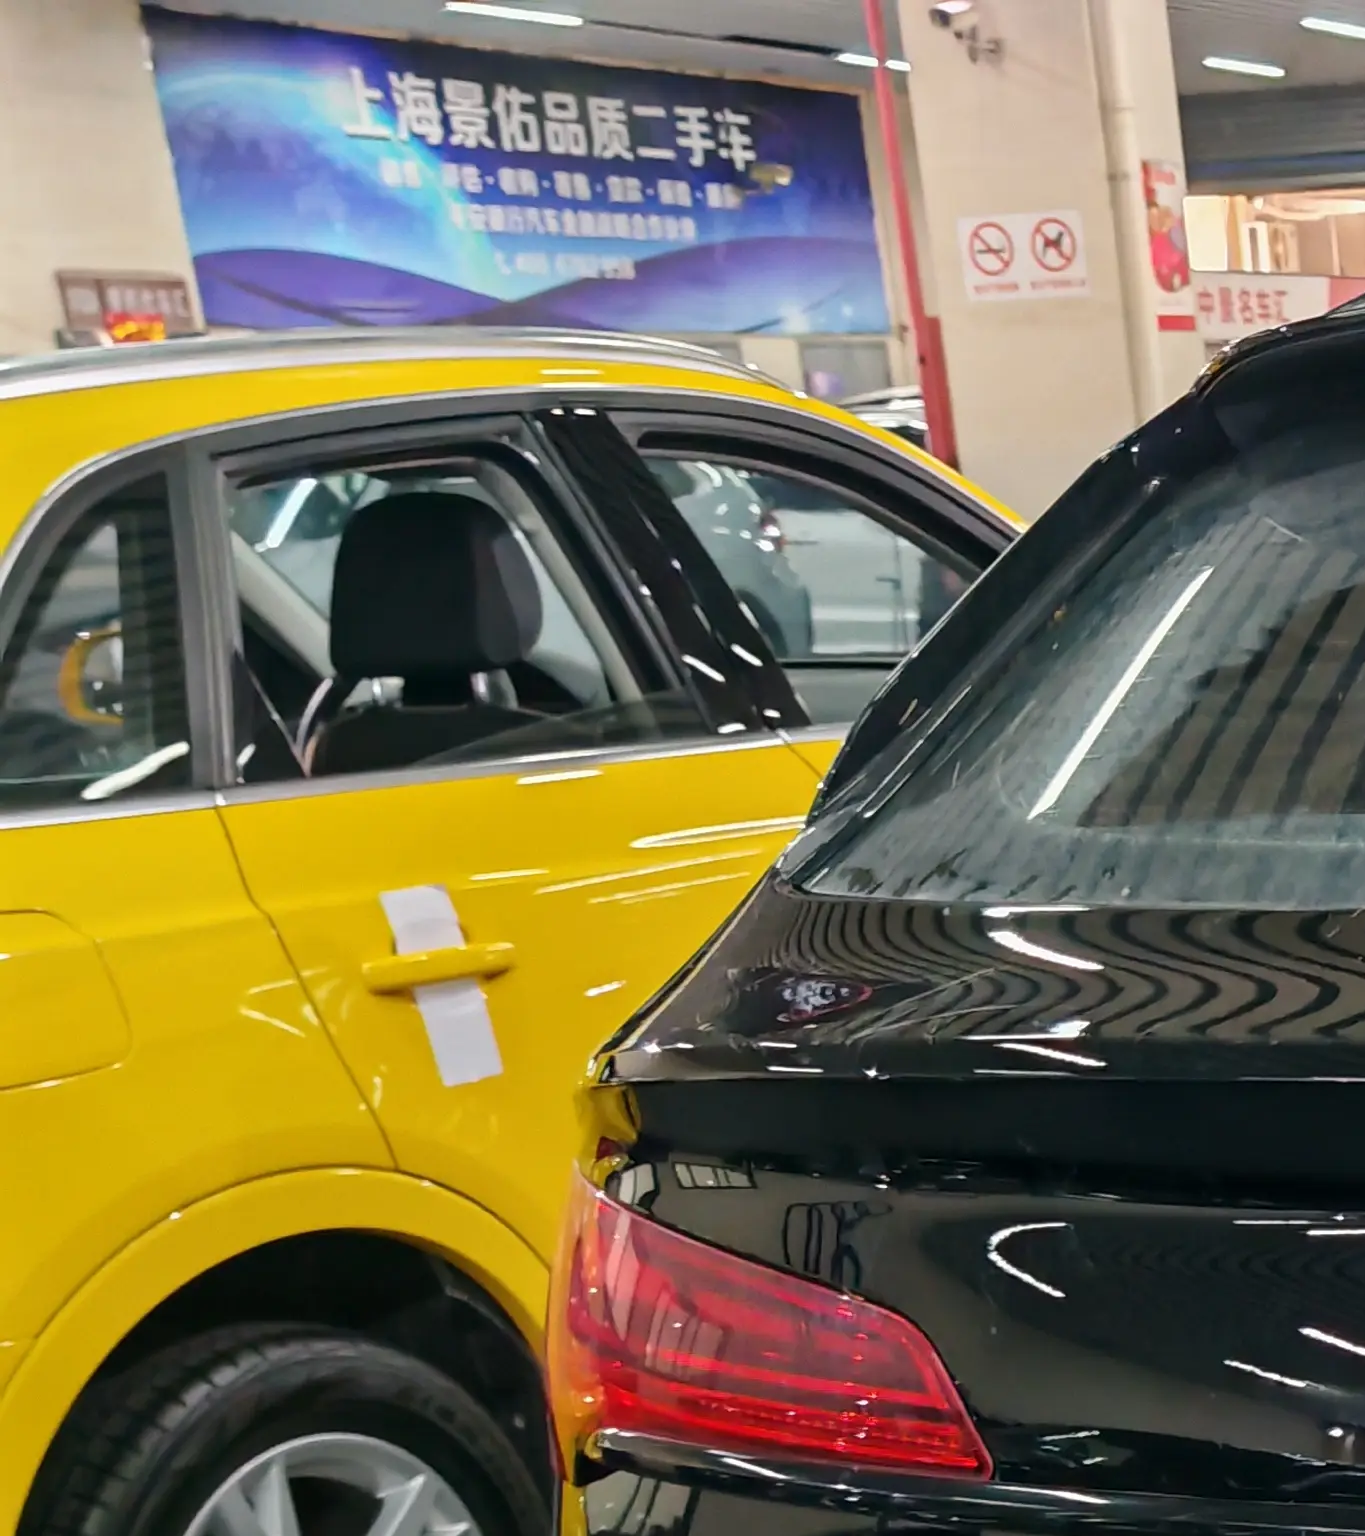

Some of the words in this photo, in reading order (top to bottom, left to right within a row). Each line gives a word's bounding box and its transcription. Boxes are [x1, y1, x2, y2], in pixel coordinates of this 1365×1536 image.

[343, 68, 758, 171] 上海景佑品质二手车
